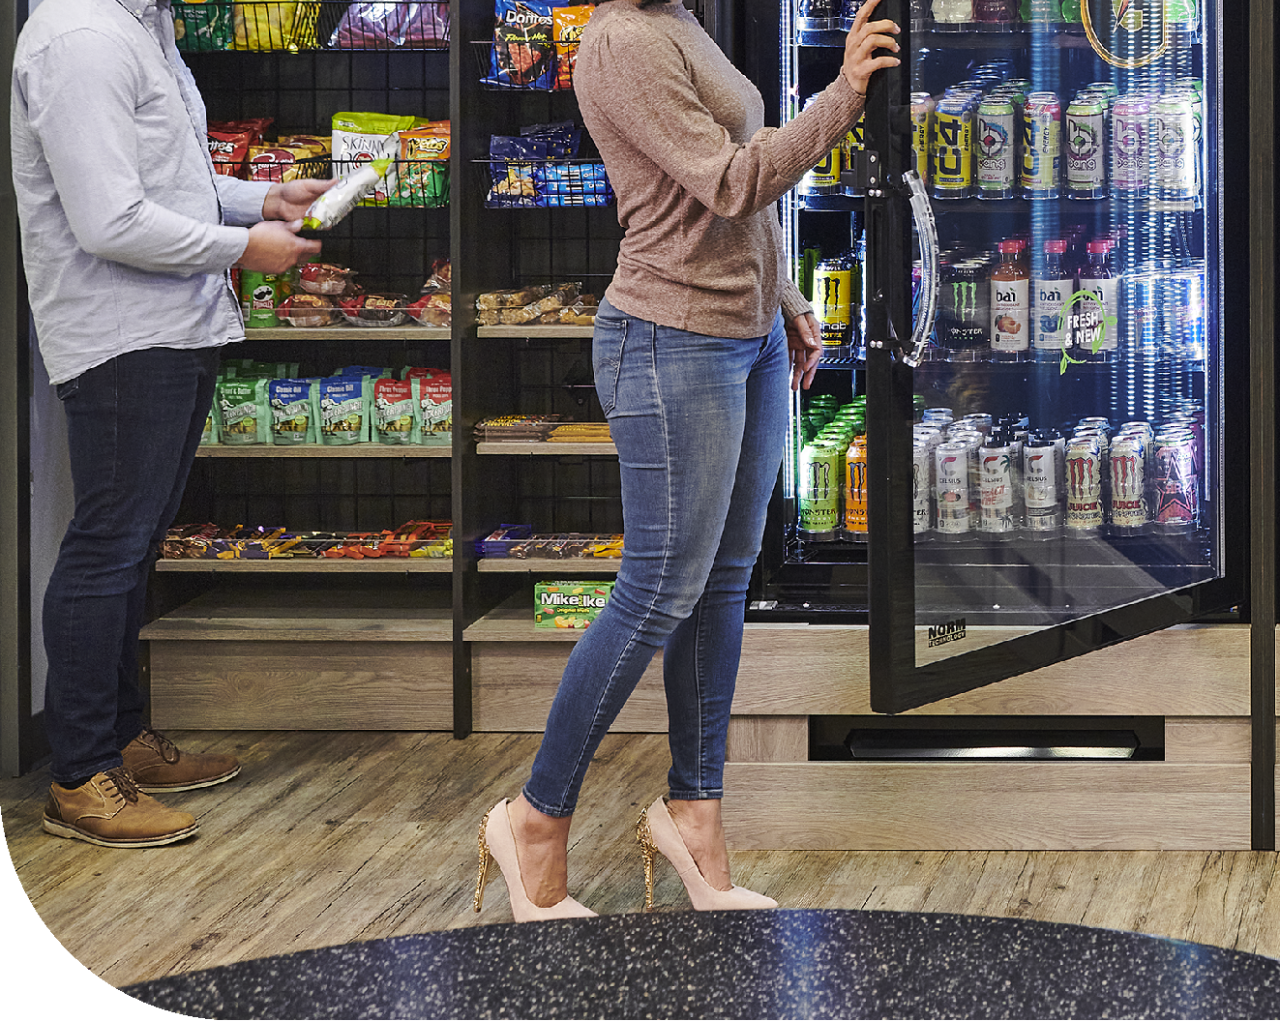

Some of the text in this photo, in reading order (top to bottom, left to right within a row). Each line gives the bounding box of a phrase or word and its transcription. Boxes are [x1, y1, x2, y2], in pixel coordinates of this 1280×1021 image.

[505, 10, 553, 25] Doritos
[939, 119, 962, 175] C4
[996, 287, 1015, 302] bai
[1040, 286, 1061, 301] bai
[1067, 312, 1098, 330] FRESH
[1064, 329, 1101, 347] & NEW
[1068, 502, 1098, 511] JUICE
[541, 593, 605, 607] Mike Ike
[928, 618, 966, 640] NORM
[929, 631, 966, 647] TECHNOLOGY
